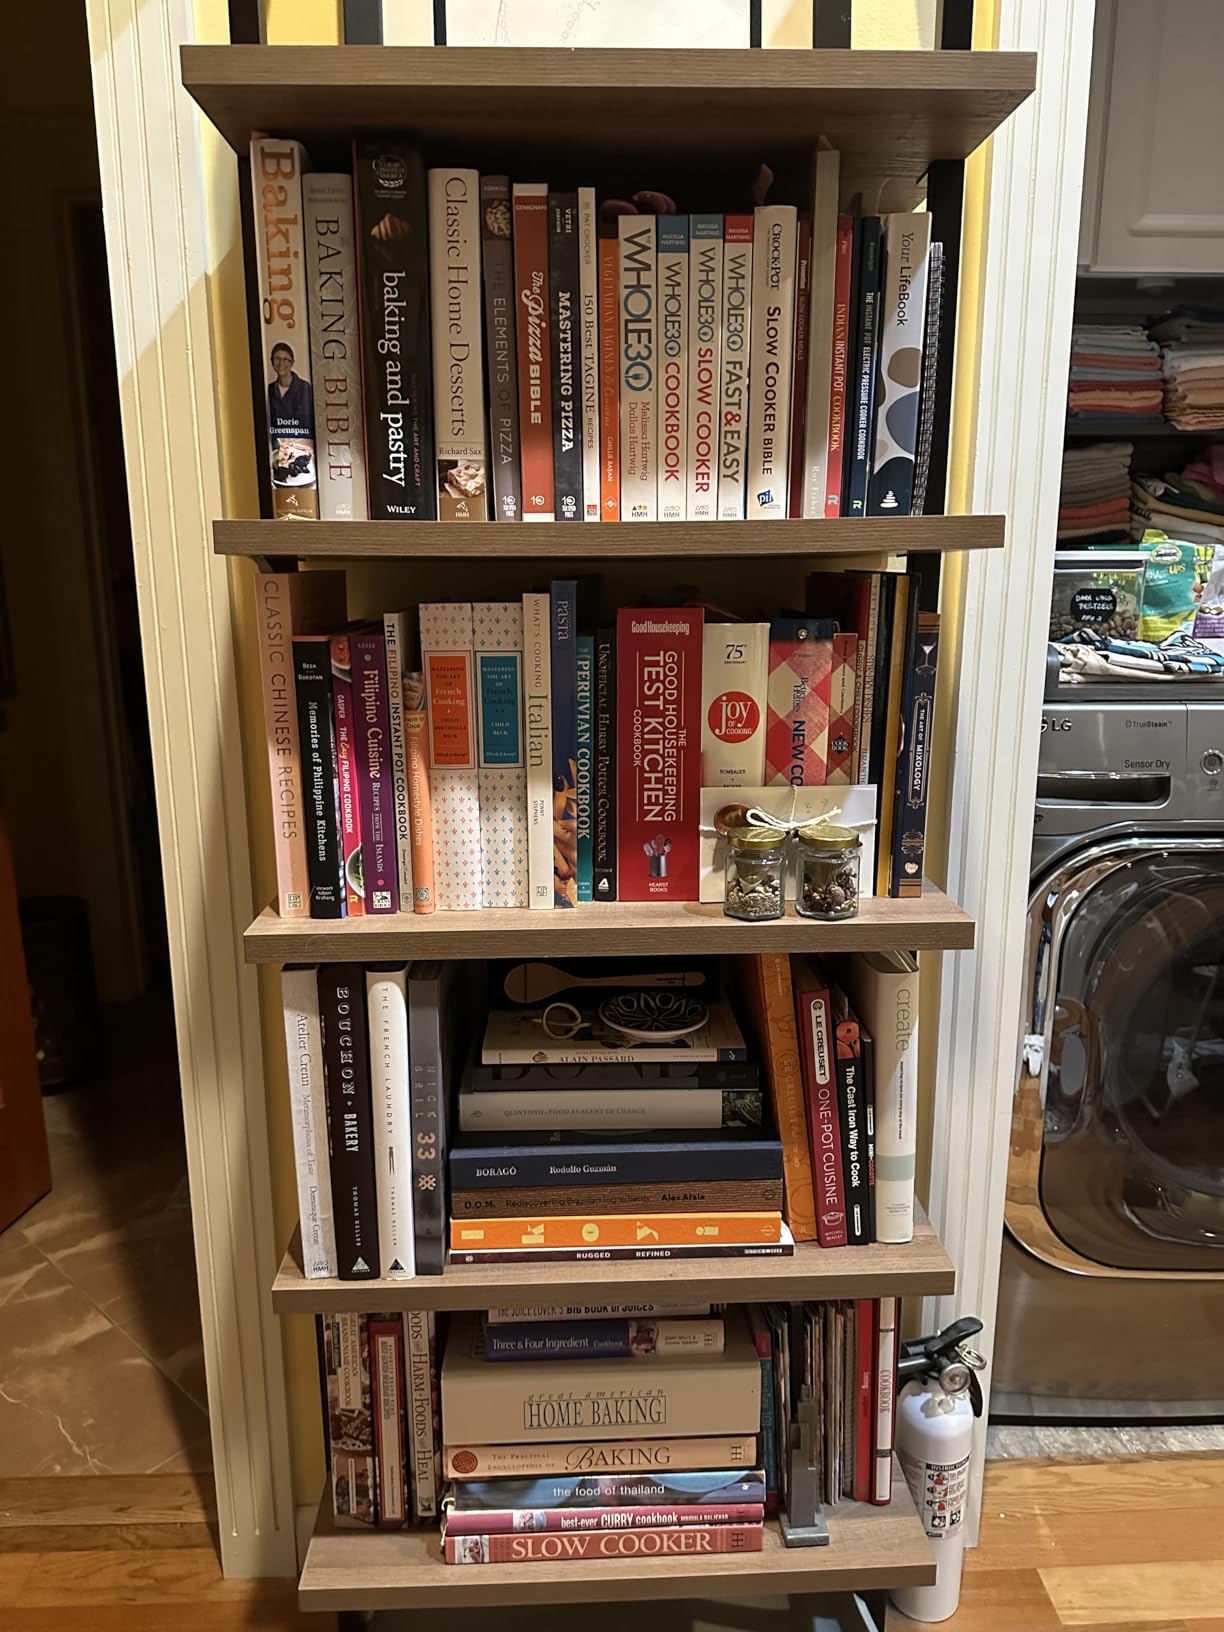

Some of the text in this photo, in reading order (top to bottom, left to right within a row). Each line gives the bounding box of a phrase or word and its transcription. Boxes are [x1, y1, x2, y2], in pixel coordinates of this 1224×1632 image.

[261, 146, 299, 329] Baking
[315, 217, 347, 360] BAKING
[445, 177, 471, 437] Classic Home Desserts
[584, 294, 595, 316] 150
[622, 228, 653, 392] WHOLE30
[727, 253, 745, 352] WHOLE30
[896, 232, 915, 327] Your LifeBook
[521, 271, 547, 424] The Pizza BIBLE
[584, 320, 596, 349] Best
[604, 256, 615, 373] VEGETARIAN TAGINES
[378, 271, 409, 487] baking and pastry
[494, 297, 513, 465] ELEMENTS PIZZA
[558, 291, 574, 452] MASTERING PIZZA
[584, 352, 597, 414] TAGINE
[664, 261, 682, 482] WHOLE30 COOKBOOK
[696, 246, 716, 493] WHOLE30 SLOW COOKER
[762, 305, 781, 475] SLOW COOKER BIBLE
[831, 303, 846, 452] INDIAN INSTANT POT COOKBOOK
[857, 346, 872, 460] ELECTRIC PRESSURE COOKER COOKBOOK
[269, 426, 310, 436] Greenspan
[276, 418, 299, 426] Dorie
[324, 376, 352, 482] BIBLE
[627, 401, 638, 476] Dallas Hartwig
[639, 401, 651, 481] Melissa Hartwig
[386, 504, 416, 514] WILEY
[386, 623, 397, 646] THE
[387, 649, 400, 699] FILIPINO
[433, 697, 466, 706] Cooking
[435, 688, 462, 696] French
[527, 598, 549, 768] WHAT'S COOKING Italian
[577, 660, 591, 743] PERUVIAN
[264, 580, 298, 839] CLASSIC CHINESE RECIPES
[391, 702, 403, 750] INSTANT
[633, 709, 642, 767] COOKBOOK
[643, 650, 664, 822] TEST KITCHEN
[664, 650, 678, 822] GOOD HOUSEKEEPING
[678, 729, 687, 747] THE
[714, 694, 753, 737] joy
[725, 727, 753, 736] COOKING
[791, 719, 806, 761] NEW
[1051, 720, 1072, 732] LG
[307, 701, 328, 862] Memories of Philippine Kitchens
[337, 694, 354, 834] CASPER THE Easy FILIPINO COOKBOOK
[361, 669, 385, 873] Filipino Cuisine RECIPES ISLANDS
[394, 752, 405, 774] POT
[912, 709, 927, 791] THE ART OF MIXOLOGY
[1124, 760, 1171, 771] Sensor Dry
[396, 777, 408, 841] COOKBOOK
[410, 736, 424, 846] Filipino Homestyle Dishes
[577, 748, 591, 840] COOKBOOK
[597, 798, 611, 862] COOKBOOK
[894, 988, 914, 1052] create
[336, 987, 359, 1153] BOUCHON BAKERY
[382, 987, 395, 1135] THE FRENCH LAUNDRY
[559, 1054, 635, 1064] ALAIN PASSARD
[296, 1013, 319, 1223] Atelier Crenn Dominique
[815, 1015, 838, 1205] LE CREUSET ONE-POT CUISINE
[845, 1066, 862, 1187] The Cast Iron Way to Cook
[416, 1131, 437, 1161] 33
[475, 1163, 617, 1178] BORAGÓ Rodolfo Guzmán
[464, 1193, 681, 1210] D.O.M. Alex
[576, 1249, 671, 1259] RUGGED REFINED
[492, 1336, 589, 1350] Three & Four Ingredient
[528, 1397, 664, 1428] HOME BAKING
[584, 1386, 666, 1400] american
[880, 1369, 892, 1413] COOKBOOK
[553, 1483, 666, 1497] the food of thailand
[564, 1445, 671, 1472] BAKING
[511, 1532, 713, 1560] SLOW COOKER
[561, 1512, 679, 1529] best-ever CURRY cookbook
